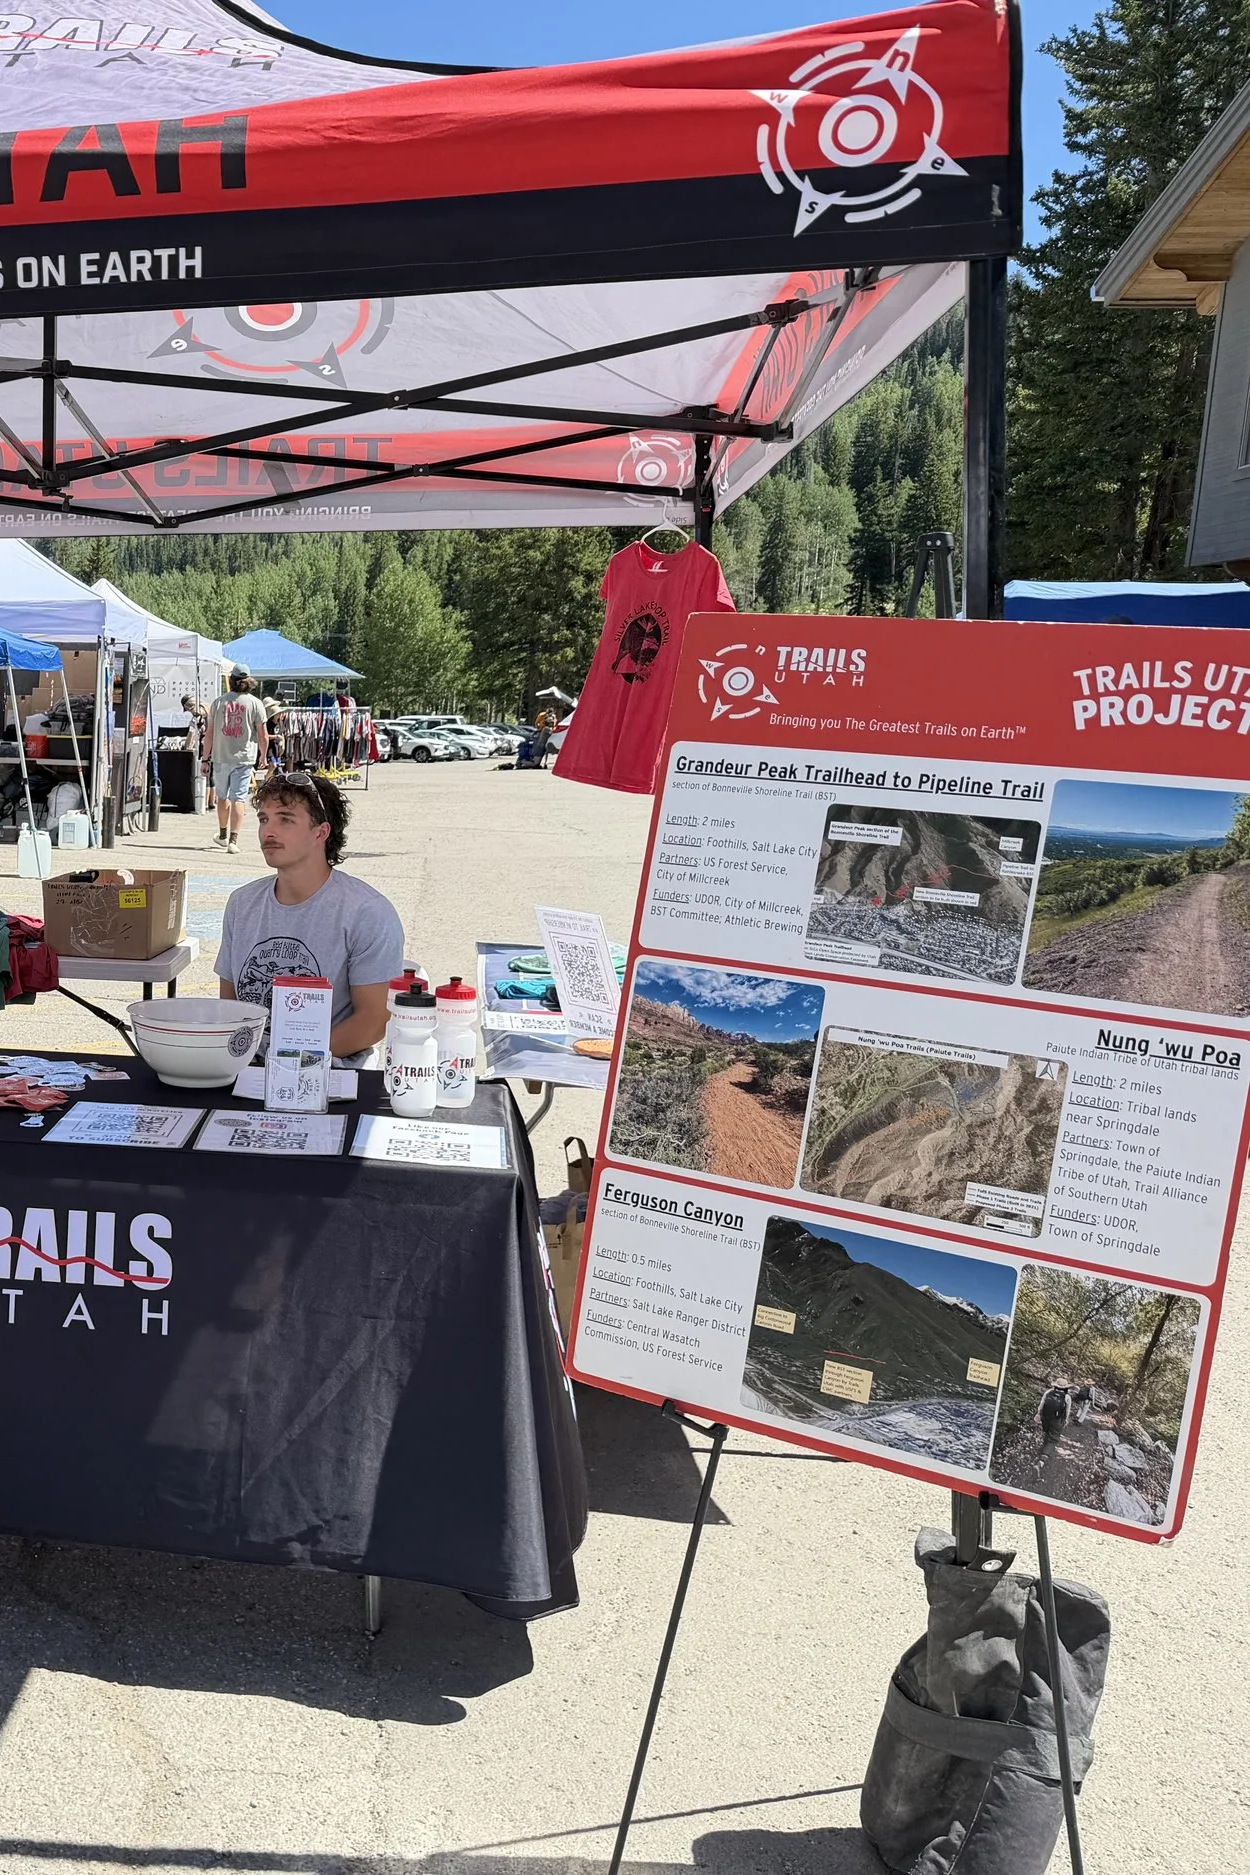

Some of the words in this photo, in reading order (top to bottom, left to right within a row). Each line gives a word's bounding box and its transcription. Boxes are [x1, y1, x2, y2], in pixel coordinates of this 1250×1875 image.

[16, 255, 68, 287] ON
[80, 246, 204, 283] EARTH
[614, 614, 633, 642] SILVER
[634, 601, 655, 615] LAKE
[661, 618, 670, 646] TRAIL
[777, 646, 867, 673] TRAILS
[774, 671, 865, 687] UTAH
[1073, 661, 1193, 696] TRAILS
[1204, 662, 1250, 698] UT
[769, 713, 817, 730] Bringing
[820, 717, 841, 730] you
[846, 717, 866, 731] The
[869, 719, 919, 735] Greatest
[924, 722, 957, 736] Trails
[961, 726, 976, 737] on
[672, 780, 700, 791] section
[702, 781, 710, 791] of
[712, 783, 753, 796] Bonneville
[754, 786, 793, 798] Shoreline
[795, 789, 813, 799] Trail
[815, 790, 837, 802] (BST)
[676, 755, 752, 777] Grandeur
[758, 761, 798, 780] Peak
[805, 765, 886, 787] Trailhead
[893, 772, 911, 790] to
[918, 774, 993, 796] Pipeline
[1001, 779, 1045, 800] Trail
[666, 814, 700, 827] Length:
[702, 816, 709, 826] 2
[711, 818, 735, 828] miles
[662, 833, 705, 847] Location:
[707, 837, 749, 851] Foothills,
[752, 841, 770, 853] Salt
[773, 843, 795, 855] Lake
[798, 845, 817, 859] City
[657, 869, 674, 882] City
[677, 872, 686, 881] of
[689, 873, 730, 886] Millcreek
[659, 852, 701, 867] Partners:
[703, 857, 715, 867] US
[718, 858, 748, 871] Forest
[751, 862, 788, 876] Service,
[653, 889, 692, 903] Funders:
[695, 893, 722, 906] UDOR,
[725, 896, 742, 910] City
[746, 899, 756, 909] of
[758, 900, 804, 916] Millcreek,
[651, 906, 667, 916] BST
[725, 915, 761, 929] Athletic
[764, 919, 803, 935] Brewing
[1046, 1042, 1077, 1057] Paiute
[1079, 1047, 1109, 1061] Indian
[1113, 1052, 1138, 1065] Tribe
[1140, 1056, 1151, 1067] of
[1154, 1059, 1178, 1071] Utah
[1180, 1062, 1208, 1076] tribal
[1211, 1067, 1239, 1080] lands
[1097, 1029, 1150, 1056] Nung
[1201, 1044, 1241, 1067] Poa
[1072, 1070, 1116, 1089] Length:
[1119, 1077, 1127, 1089] 2
[1130, 1079, 1162, 1096] miles
[1069, 1091, 1123, 1112] Location:
[1127, 1100, 1161, 1117] Tribal
[1165, 1105, 1197, 1123] lands
[1066, 1112, 1093, 1126] near
[1096, 1116, 1160, 1137] Springdale
[1062, 1130, 1113, 1150] Partners:
[1116, 1140, 1145, 1155] Town
[1148, 1146, 1161, 1158] of
[1060, 1149, 1120, 1171] Springdale,
[1124, 1160, 1142, 1173] the
[1146, 1164, 1182, 1181] Paiute
[1185, 1171, 1221, 1188] Indian
[1054, 1185, 1066, 1196] of
[1068, 1187, 1118, 1207] Southern
[1122, 1195, 1148, 1212] Utah
[1057, 1166, 1084, 1181] Tribe
[1088, 1173, 1100, 1184] of
[1102, 1175, 1130, 1191] Utah,
[1135, 1180, 1159, 1195] Trail
[1163, 1185, 1208, 1204] Alliance
[603, 1182, 678, 1213] Ferguson
[683, 1201, 744, 1229] Canyon
[1050, 1204, 1100, 1226] Funders:
[1104, 1214, 1139, 1233] UDOR,
[1048, 1223, 1078, 1239] Town
[1081, 1230, 1092, 1242] of
[1097, 1232, 1161, 1257] Springdale
[596, 1245, 630, 1262] Length:
[632, 1253, 645, 1265] 0.5
[647, 1257, 672, 1272] miles
[593, 1266, 634, 1286] Location:
[635, 1277, 677, 1298] Foothills,
[680, 1288, 697, 1302] Salt
[700, 1293, 722, 1307] Lake
[724, 1299, 743, 1315] City
[590, 1287, 630, 1308] Partners:
[632, 1298, 650, 1312] Salt
[652, 1304, 673, 1318] Lake
[676, 1310, 708, 1329] Ranger
[712, 1319, 746, 1338] District
[587, 1309, 625, 1329] Funders:
[627, 1320, 659, 1337] Central
[662, 1329, 700, 1348] Wasatch
[584, 1326, 640, 1351] Commission,
[642, 1337, 654, 1353] US
[657, 1343, 685, 1362] Forest
[688, 1353, 723, 1372] Service
